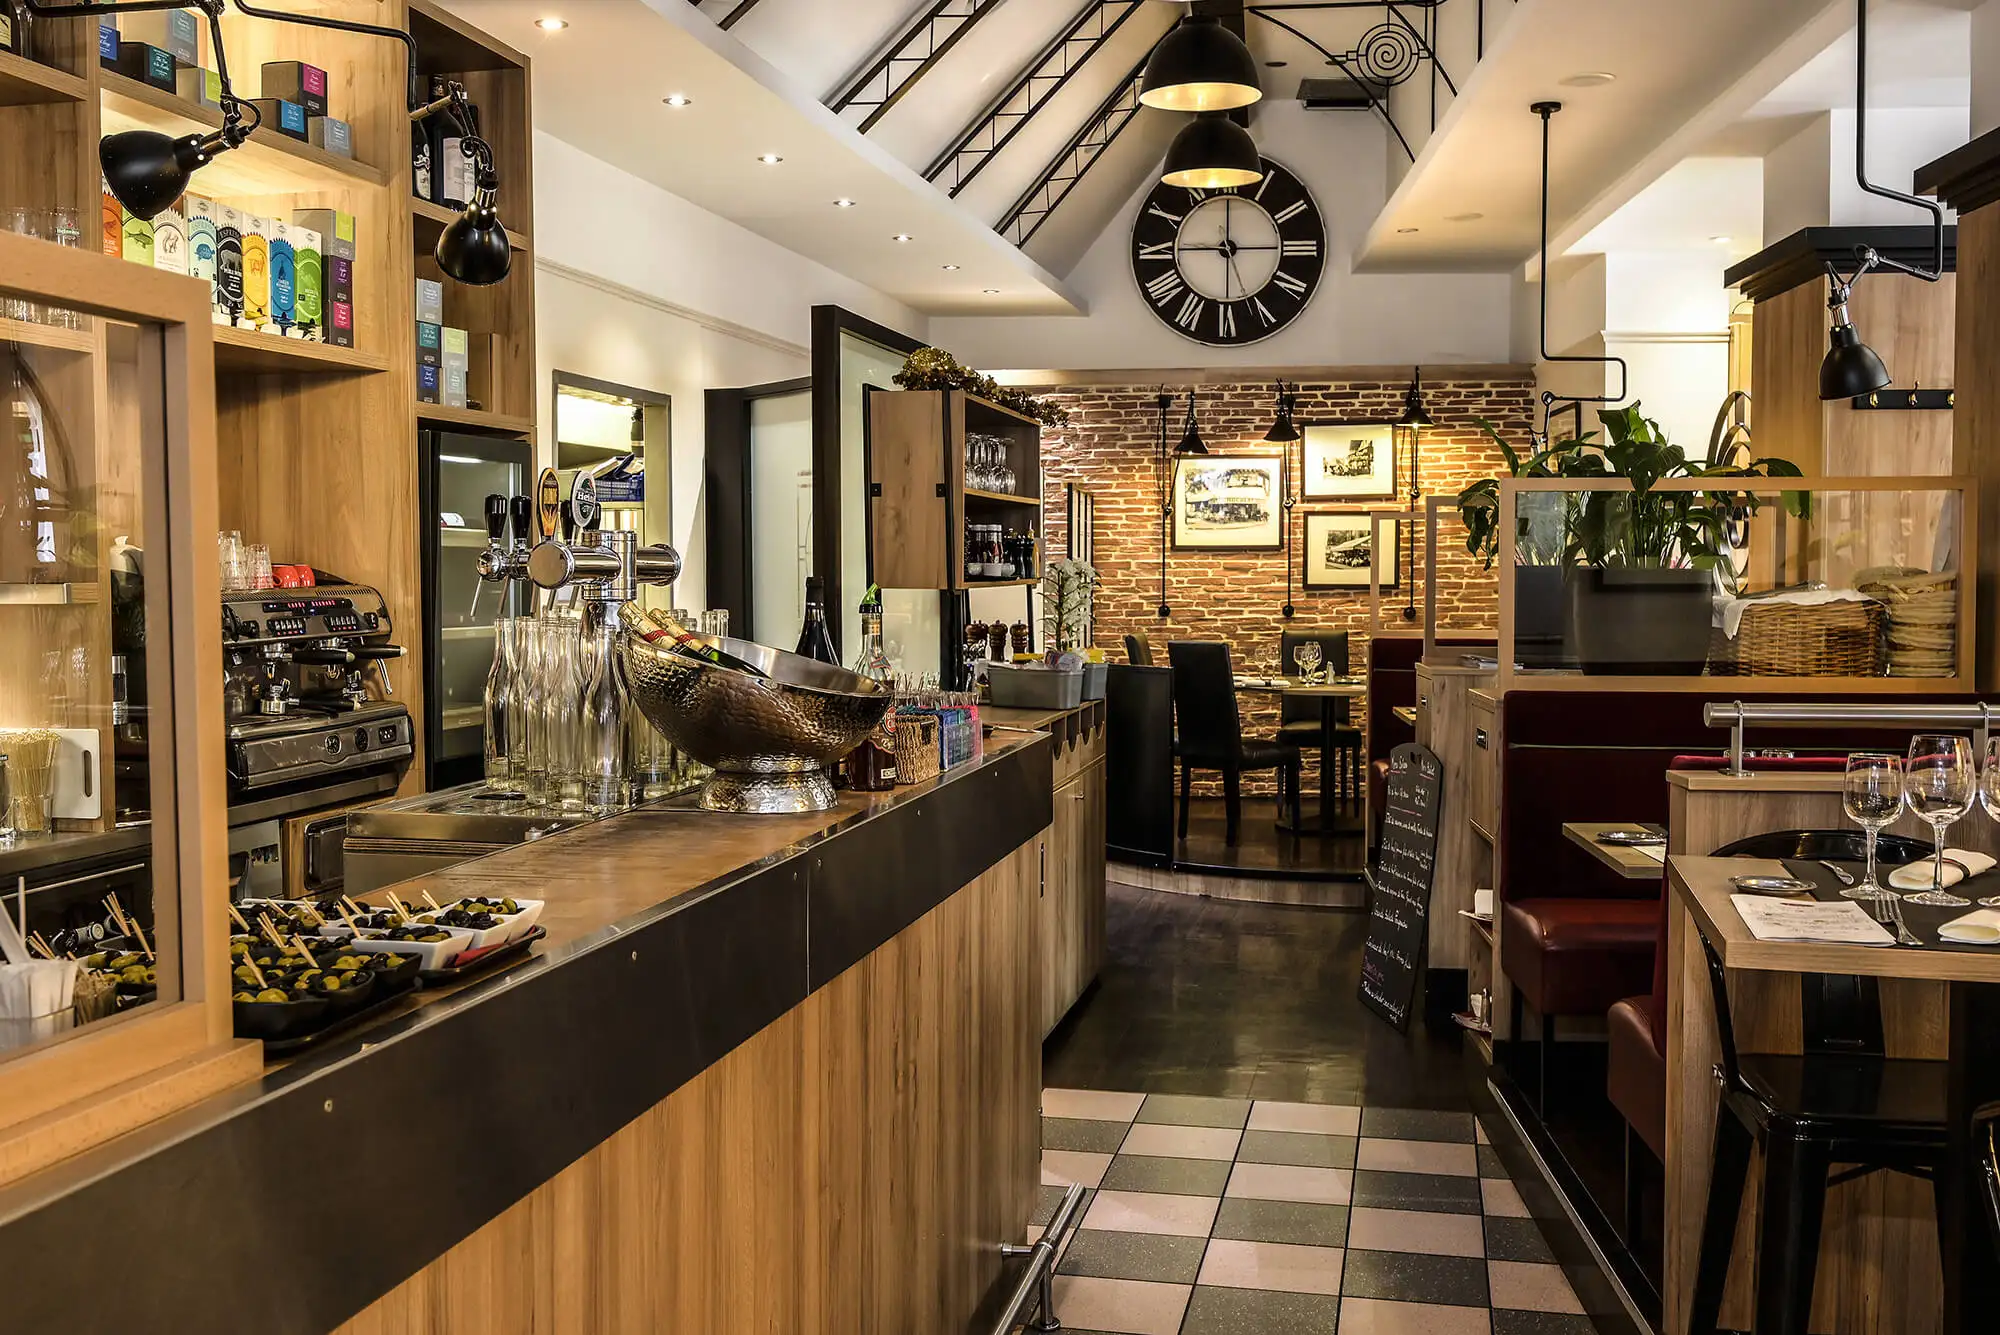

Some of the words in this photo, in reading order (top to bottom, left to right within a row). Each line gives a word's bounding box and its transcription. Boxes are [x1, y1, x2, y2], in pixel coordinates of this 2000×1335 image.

[1148, 201, 1183, 230] X
[1274, 200, 1309, 224] II
[1139, 241, 1173, 260] IX
[1282, 240, 1318, 257] III
[1145, 269, 1184, 308] VIII
[1175, 292, 1205, 332] VII
[1218, 303, 1237, 338] VI
[1253, 296, 1277, 328] V
